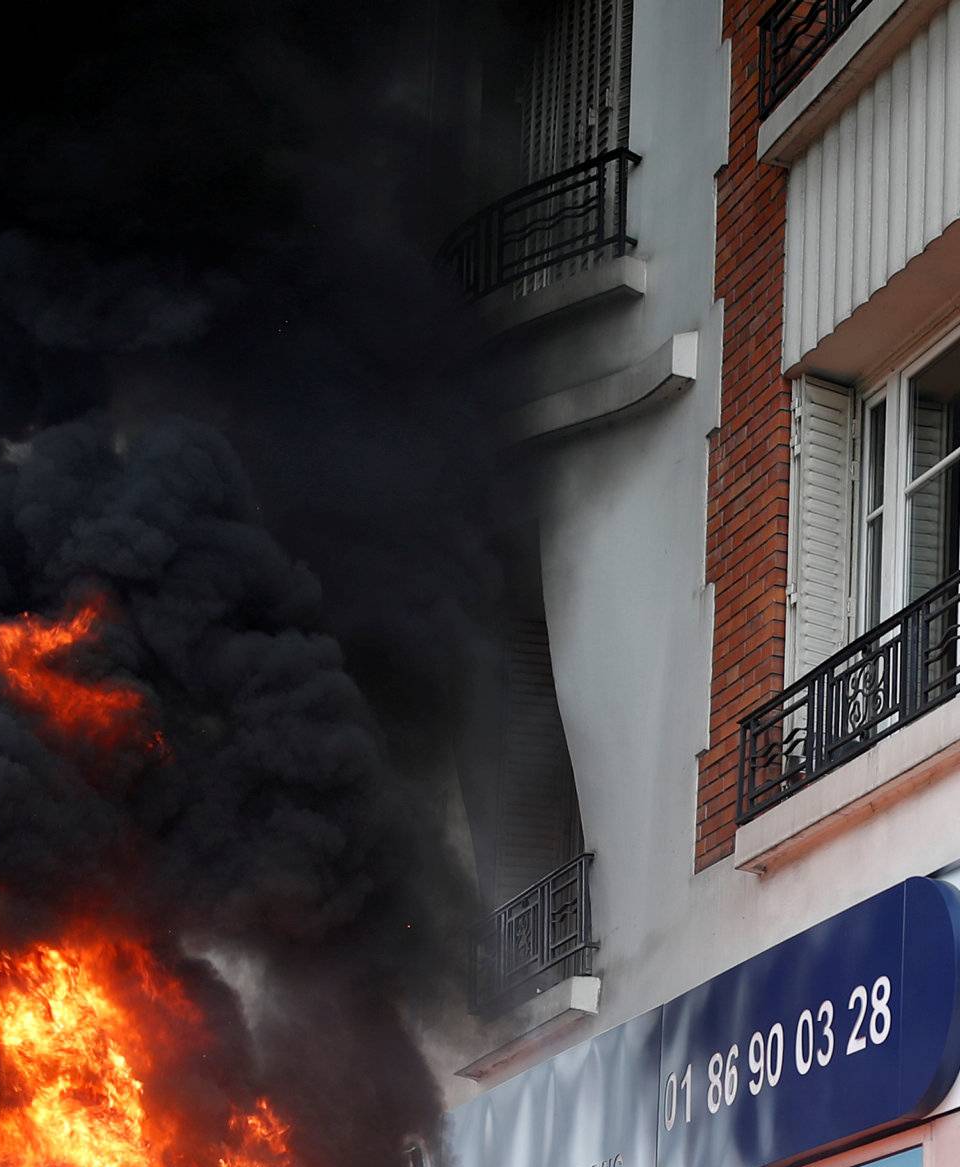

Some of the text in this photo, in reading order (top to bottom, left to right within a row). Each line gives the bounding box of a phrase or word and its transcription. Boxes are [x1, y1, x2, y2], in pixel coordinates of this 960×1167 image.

[664, 975, 891, 1131] 01 86 90 03 28
